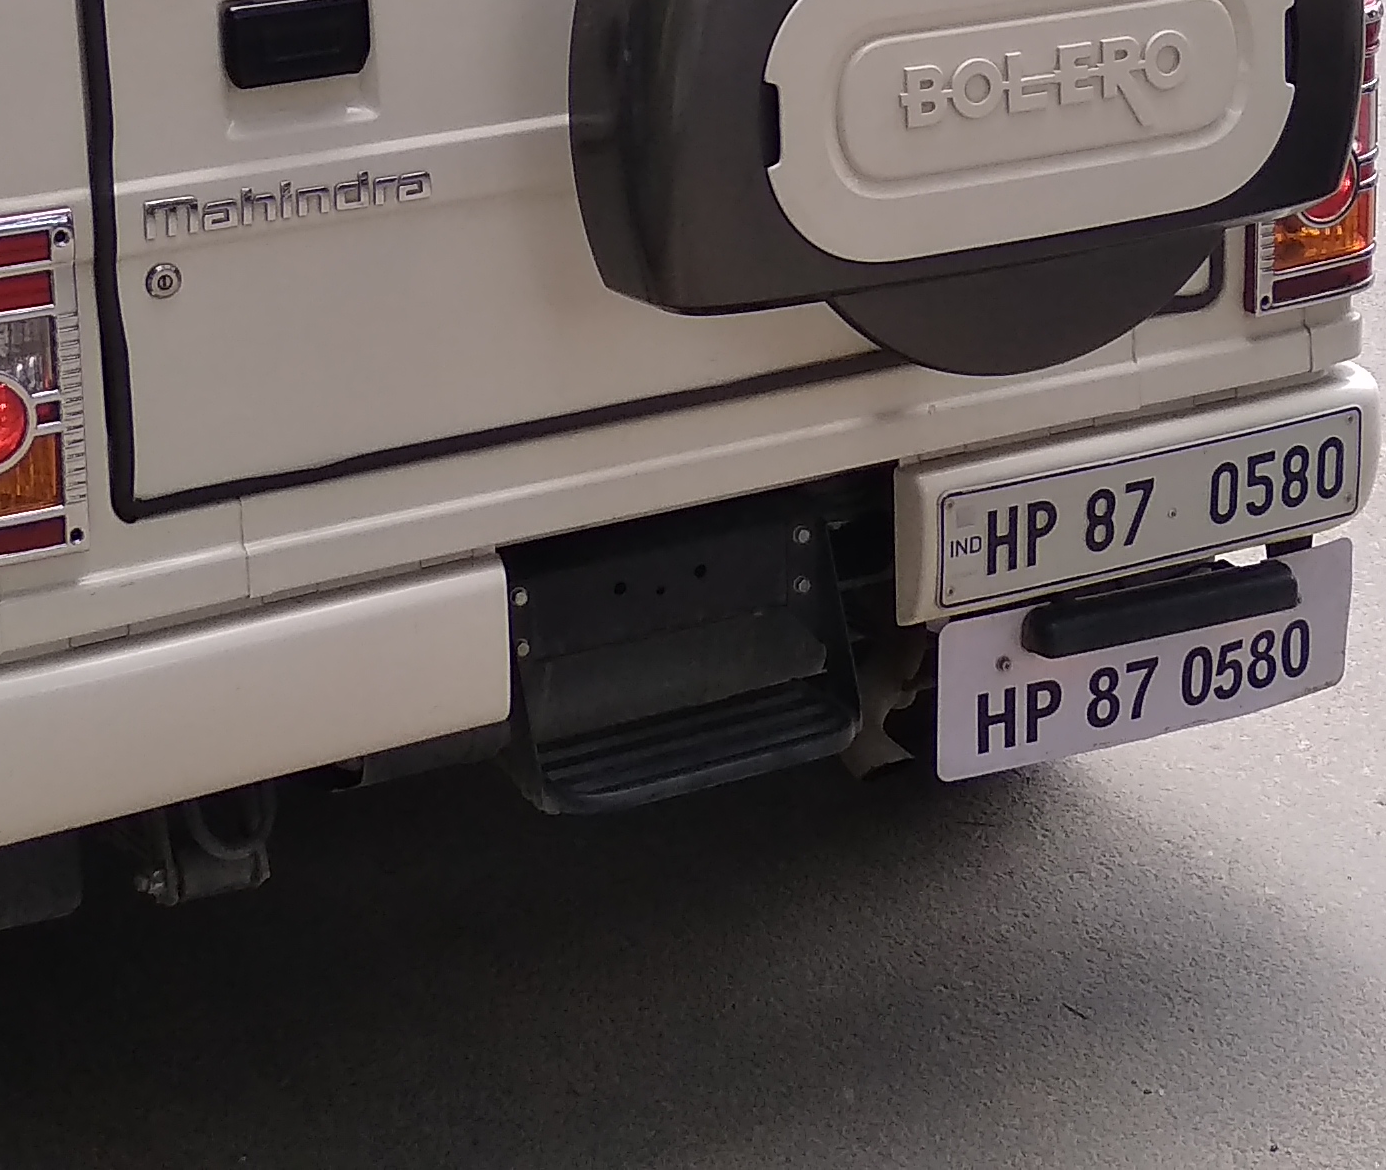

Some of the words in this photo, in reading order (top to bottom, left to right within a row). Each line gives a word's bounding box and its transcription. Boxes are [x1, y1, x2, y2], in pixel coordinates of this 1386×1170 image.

[899, 29, 1190, 130] BOLERO
[949, 534, 982, 557] IND
[986, 499, 1058, 576] HP
[1085, 477, 1156, 553] 87
[1209, 436, 1344, 525] 0580
[976, 679, 1063, 756] HP
[1086, 656, 1160, 730] 87
[1181, 618, 1311, 707] 0580
